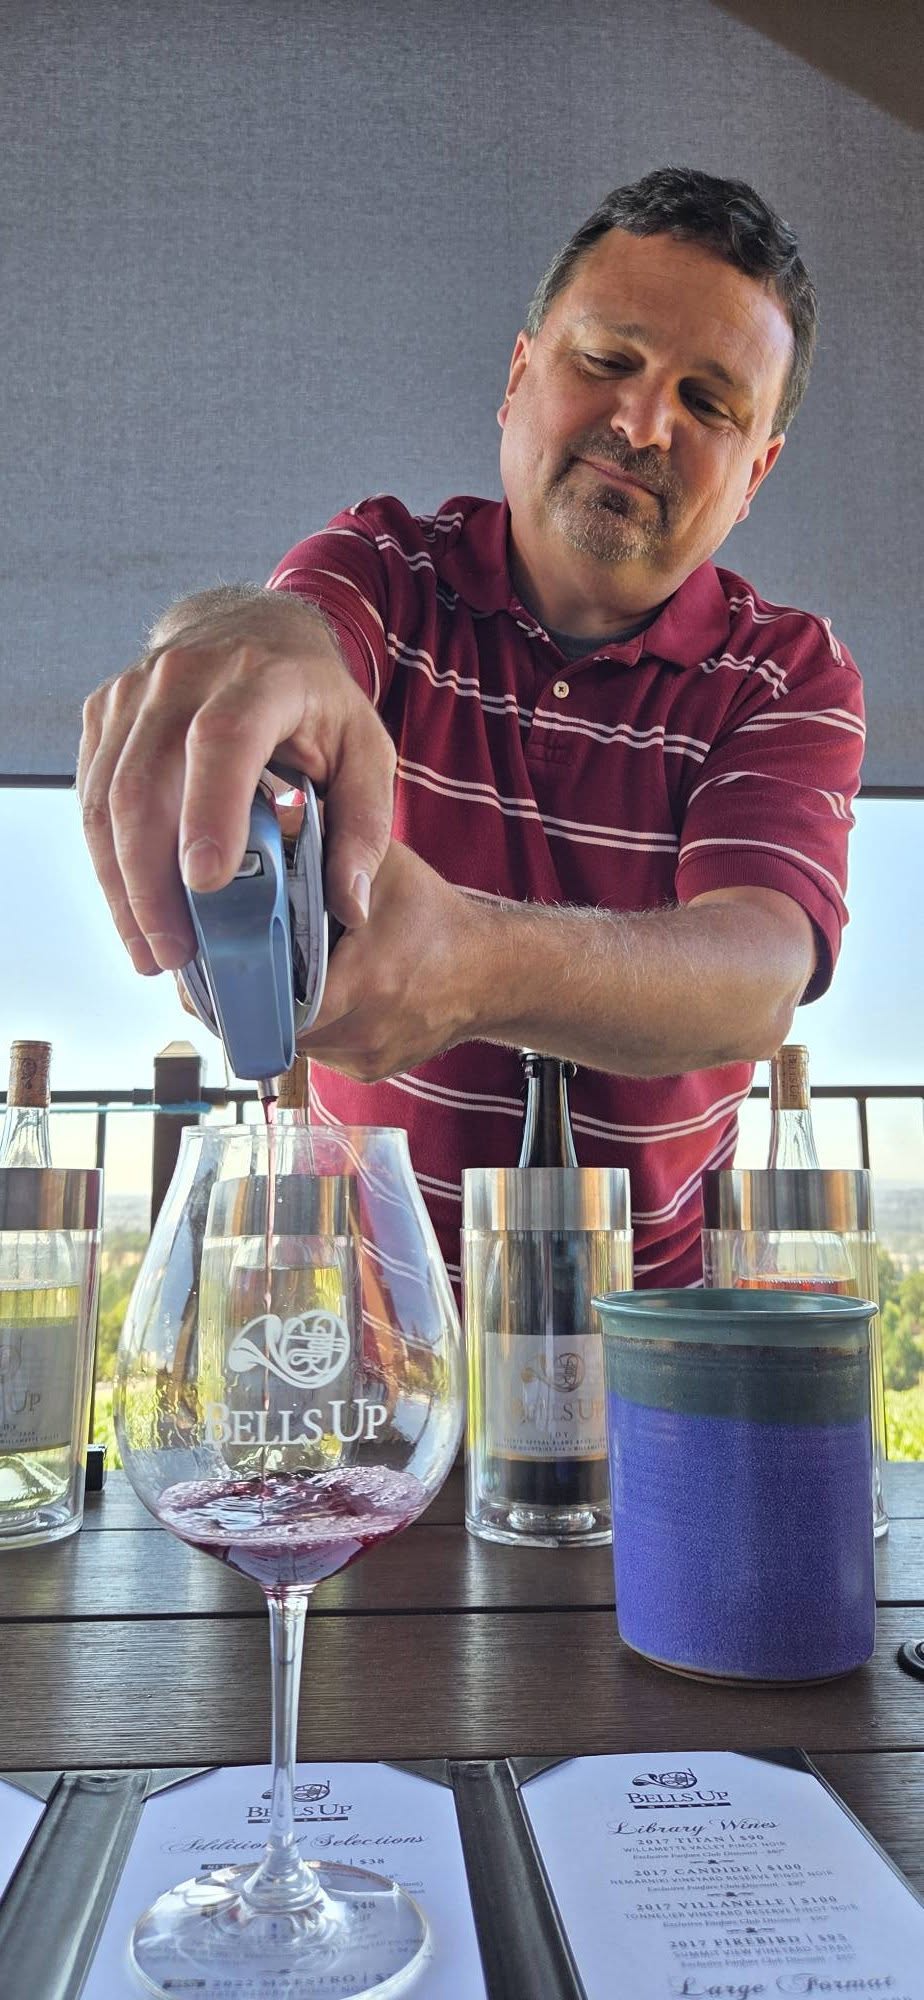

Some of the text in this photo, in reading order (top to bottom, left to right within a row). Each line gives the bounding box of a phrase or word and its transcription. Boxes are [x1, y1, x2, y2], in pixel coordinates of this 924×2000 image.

[204, 1398, 388, 1446] BELLS UP
[625, 1789, 729, 1804] BELLS UP
[319, 1803, 353, 1816] UP
[608, 1817, 781, 1836] Library Wines
[311, 1832, 426, 1848] Selections
[358, 1857, 386, 1866] $38
[674, 1865, 752, 1875] CANDIDE
[767, 1863, 802, 1871] $100
[636, 1903, 671, 1911] 2017
[678, 1898, 785, 1909] VILLANELLE
[800, 1895, 837, 1904] $100
[669, 1939, 706, 1948] 2017
[713, 1935, 800, 1947] FIREBIRD
[673, 1973, 896, 2000] Large Format
